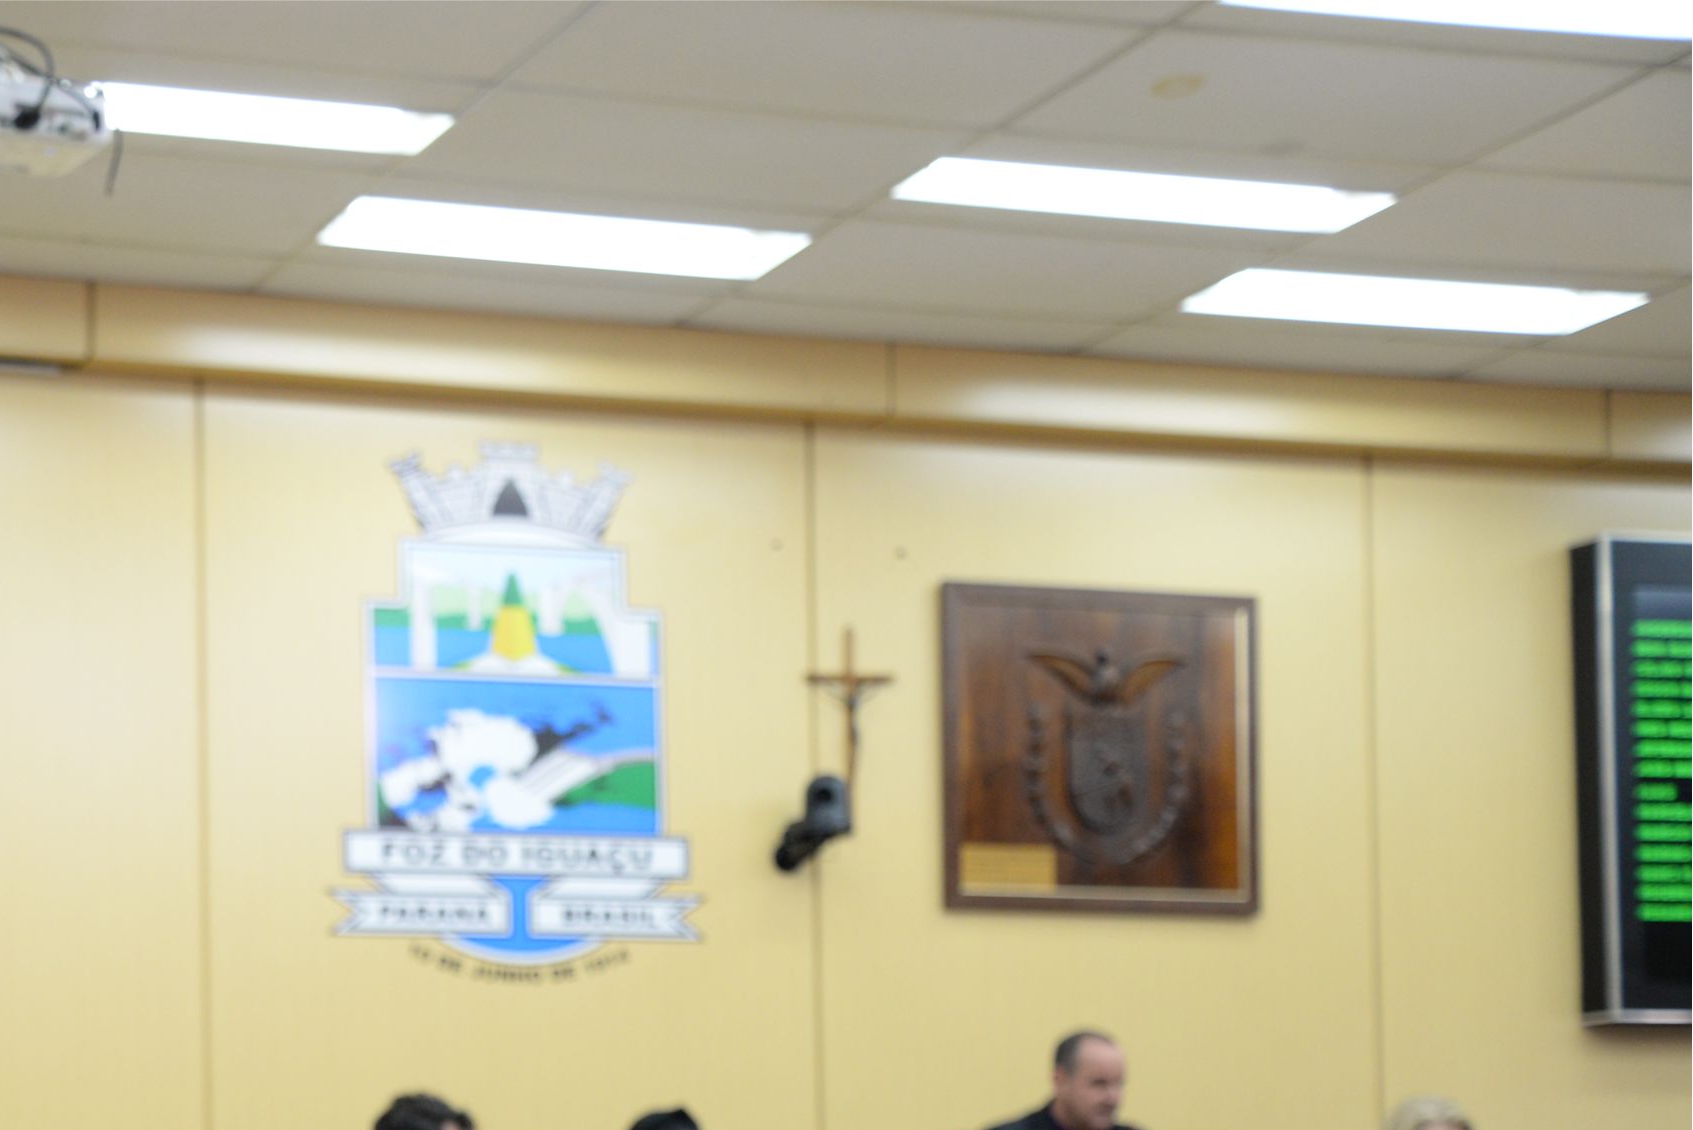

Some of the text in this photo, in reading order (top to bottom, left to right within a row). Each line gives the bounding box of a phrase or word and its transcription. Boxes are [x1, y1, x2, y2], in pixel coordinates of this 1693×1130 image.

[381, 843, 655, 875] FOZ DO IGUAÇU
[377, 903, 491, 924] PARANÁ
[560, 907, 657, 927] BRASIL
